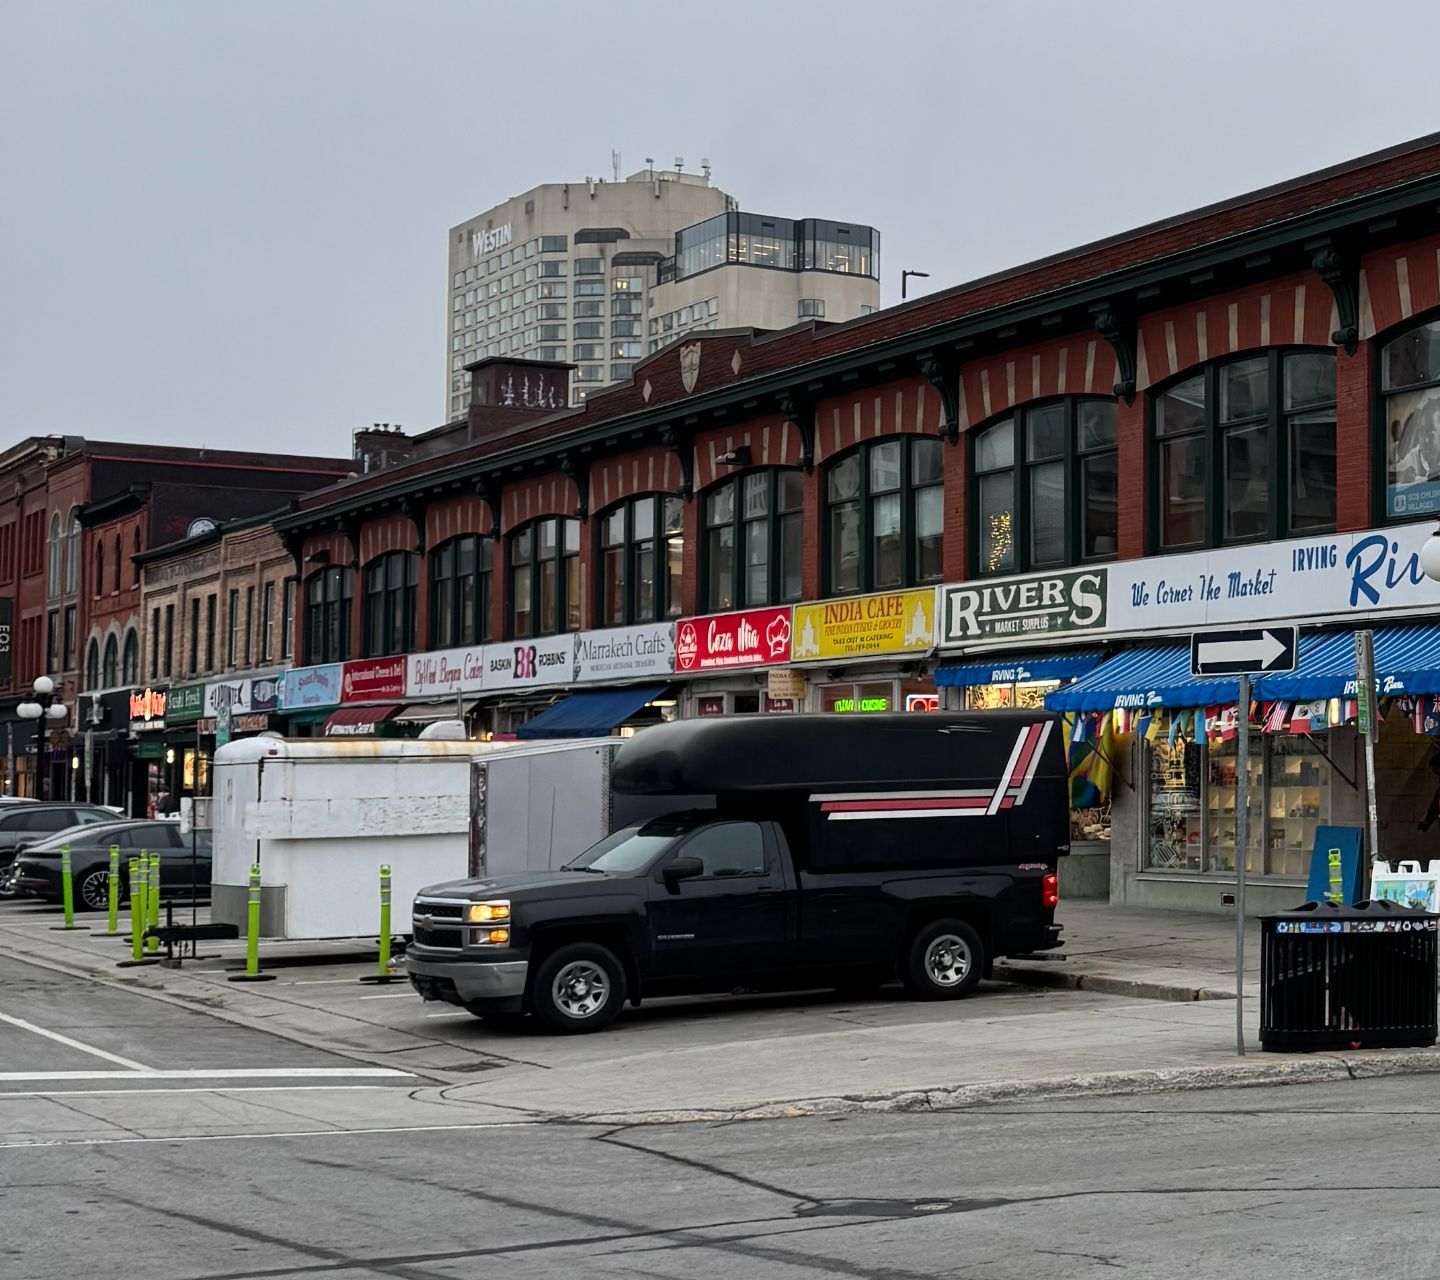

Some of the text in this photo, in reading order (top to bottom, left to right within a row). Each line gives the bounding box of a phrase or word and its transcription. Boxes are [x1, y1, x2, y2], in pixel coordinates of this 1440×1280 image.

[473, 222, 512, 256] WESTIN
[1292, 545, 1337, 572] IRVING
[1131, 569, 1277, 607] We Corner The Market
[824, 595, 904, 625] INDIA CAFE
[949, 574, 1102, 637] RIVERS
[865, 632, 894, 642] CATERING
[994, 616, 1049, 634] MARKET SURPLUS
[582, 631, 666, 661] Marrakech Crafts
[352, 666, 375, 682] International
[375, 665, 390, 679] Cheese
[393, 663, 401, 677] Deli
[490, 645, 566, 679] BASKIN BR ROBBINS
[992, 669, 1014, 682] IRVING
[1114, 693, 1145, 708] IRVING
